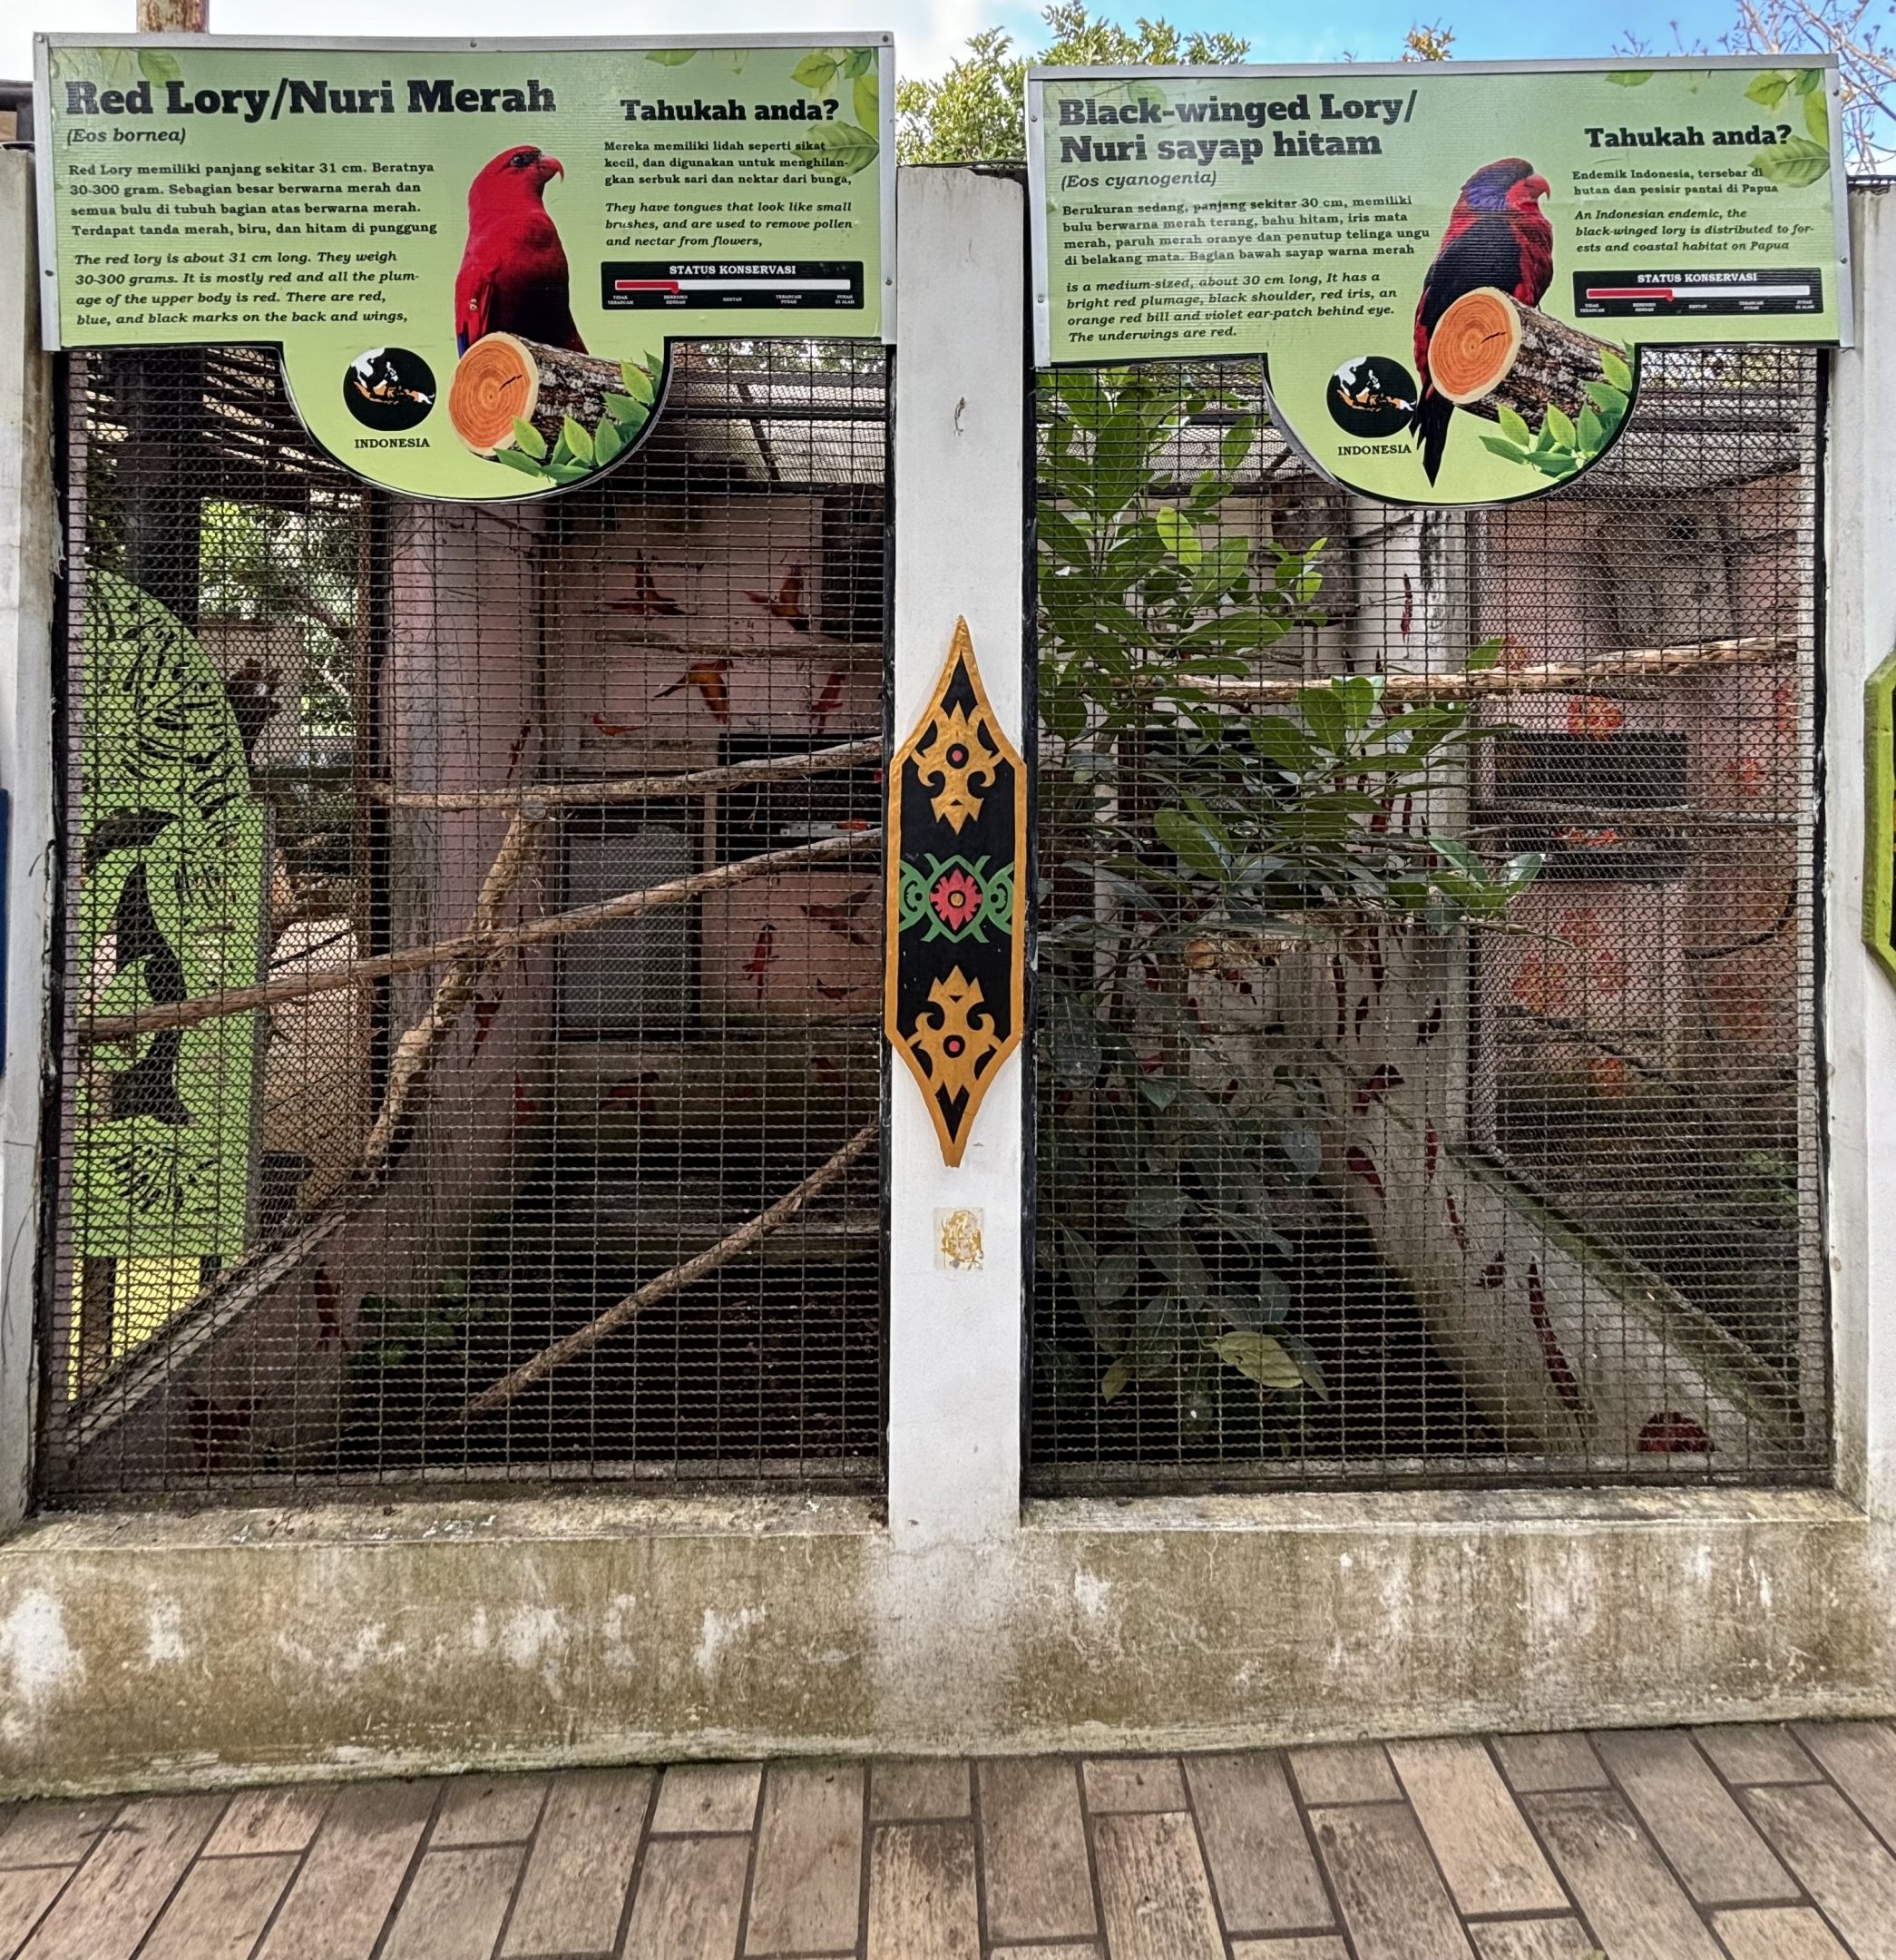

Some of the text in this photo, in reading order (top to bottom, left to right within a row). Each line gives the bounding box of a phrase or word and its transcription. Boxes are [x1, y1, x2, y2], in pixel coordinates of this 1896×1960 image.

[65, 78, 556, 122] Red Lory/Nuri Merah
[620, 99, 838, 120] Tahukah anda?
[1058, 89, 1418, 129] Black-winged Lory/
[66, 127, 185, 145] (Eos bornea)
[1584, 124, 1791, 147] Tahukah anda?
[604, 141, 826, 152] Mereka memiliki lidah seperti sikat
[1060, 131, 1383, 165] Nuri sayap hitam
[68, 164, 95, 175] Red
[100, 164, 132, 177] Lory
[137, 163, 200, 173] memiliki
[205, 163, 261, 176] panjang
[265, 162, 315, 172] sekitar
[318, 162, 336, 172] 31
[372, 162, 434, 174] Beratnya
[604, 158, 638, 168] kecil,
[642, 158, 665, 167] dan
[669, 157, 734, 169] digunakan
[738, 157, 775, 166] untuk
[604, 172, 852, 186] gkan serbuk sari dan nektar dari bunga,
[1060, 171, 1216, 191] (Eos cyanogenia)
[69, 181, 420, 197] 30-300 gram. Sebagian besar berwarna merah dan
[1573, 183, 1778, 195] hutan dan pesisir pantai di Papua
[71, 201, 420, 216] semua bulu di tubuh bagian atas berwarna merah.
[605, 201, 851, 214] They have tongues that look like small
[1574, 208, 1746, 220] An Indonesian endemic, the
[71, 222, 436, 238] Terdapat tanda merah, biru, dan hitam di punggung
[605, 219, 658, 230] brushes,
[662, 219, 687, 228] and
[716, 219, 745, 228] used
[749, 220, 761, 228] to
[812, 219, 852, 230] pollen
[1575, 225, 1657, 237] black-winged
[1662, 225, 1686, 237] lory
[1690, 225, 1700, 234] is
[1704, 224, 1773, 234] distributed
[1776, 224, 1789, 233] to
[605, 235, 762, 248] and nectar from flowers,
[1576, 243, 1600, 252] ests
[1604, 241, 1628, 251] and
[1632, 241, 1677, 250] coastal
[1682, 241, 1727, 250] habitat
[1749, 240, 1789, 251] Papua
[74, 250, 396, 266] The red lory is about 31 cm long. They weigh
[669, 265, 796, 274] STATUS KONSERVASI
[1637, 272, 1757, 282] STATUS KONSERVASI
[74, 274, 124, 284] 30-300
[128, 276, 178, 286] grams.
[182, 272, 195, 283] It
[199, 272, 211, 282] is
[216, 272, 263, 285] mostly
[269, 271, 291, 282] red
[296, 271, 324, 281] and
[327, 270, 347, 281] all
[352, 270, 375, 281] the
[1067, 298, 1109, 310] bright
[1113, 296, 1136, 307] red
[1139, 296, 1204, 309] plumage,
[1207, 292, 1246, 302] black
[1250, 290, 1314, 301] shoulder,
[1320, 289, 1343, 299] red
[1347, 289, 1373, 299] iris,
[1067, 305, 1393, 327] orange red bill and violet ear-patch behind eye.
[354, 437, 430, 448] INDONESIA
[1337, 445, 1412, 455] INDONESIA
